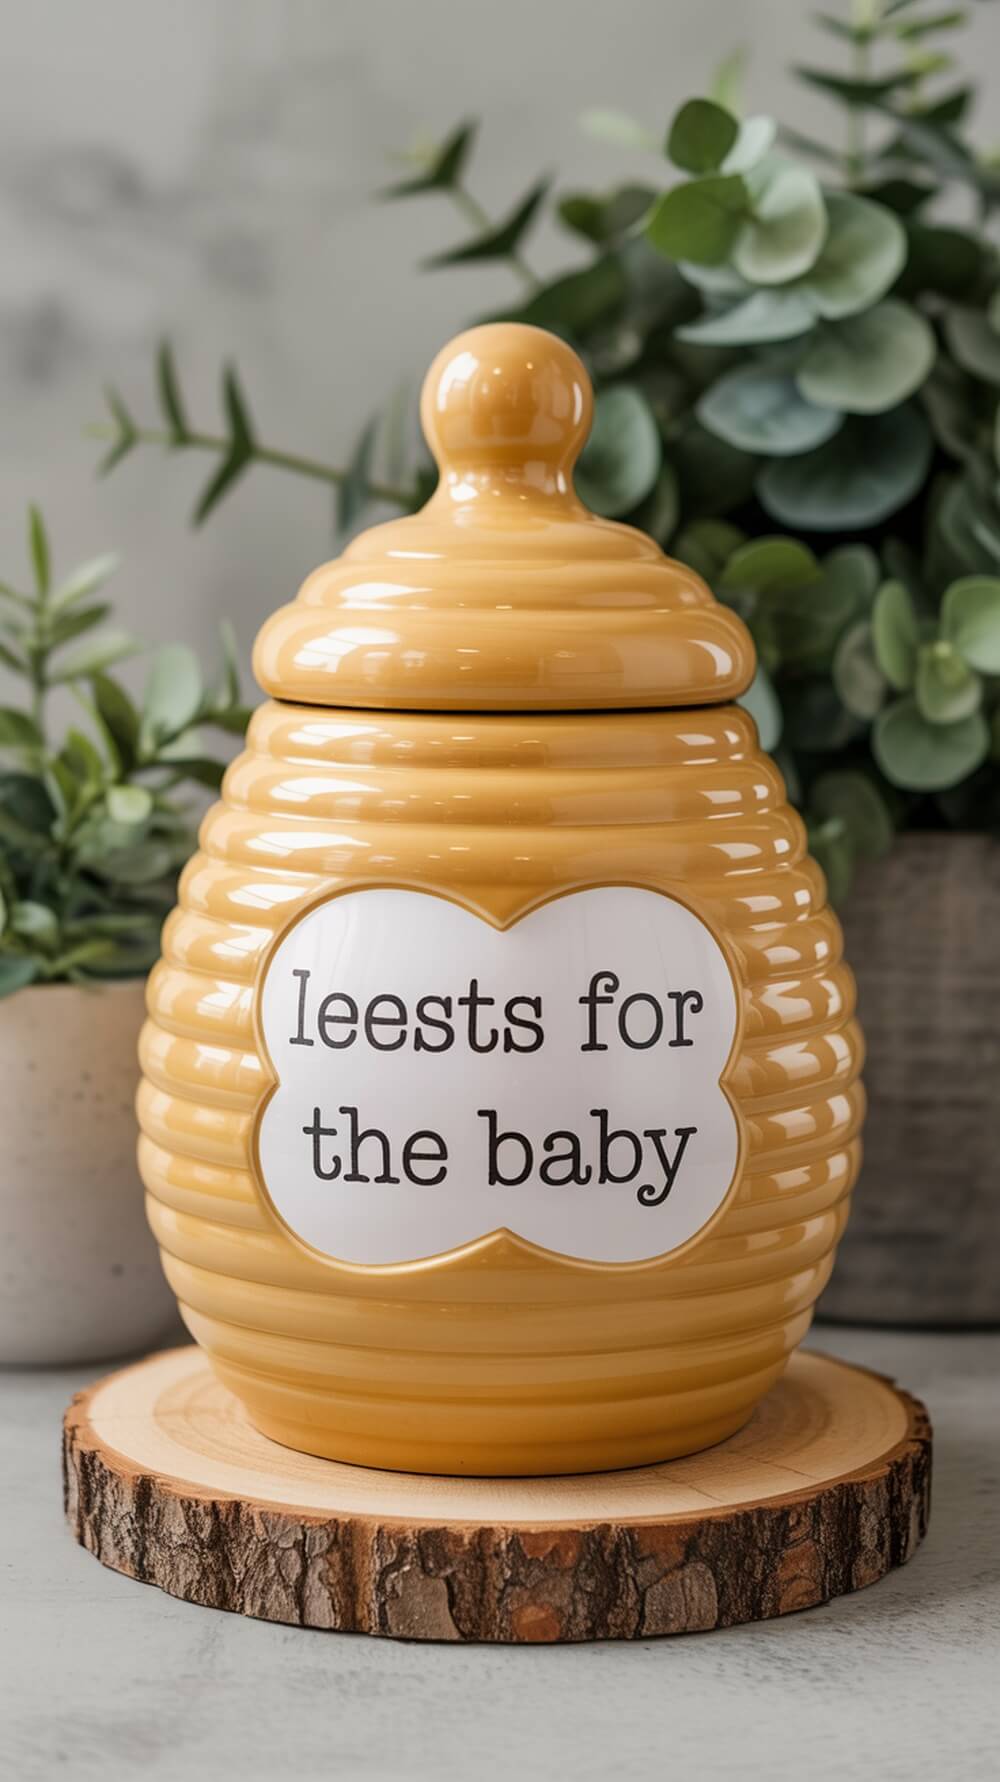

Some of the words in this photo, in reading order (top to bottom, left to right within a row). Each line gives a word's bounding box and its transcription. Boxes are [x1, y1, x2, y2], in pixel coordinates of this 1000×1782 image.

[578, 970, 704, 1052] for
[302, 1106, 449, 1187] the
[476, 1108, 698, 1207] baby
